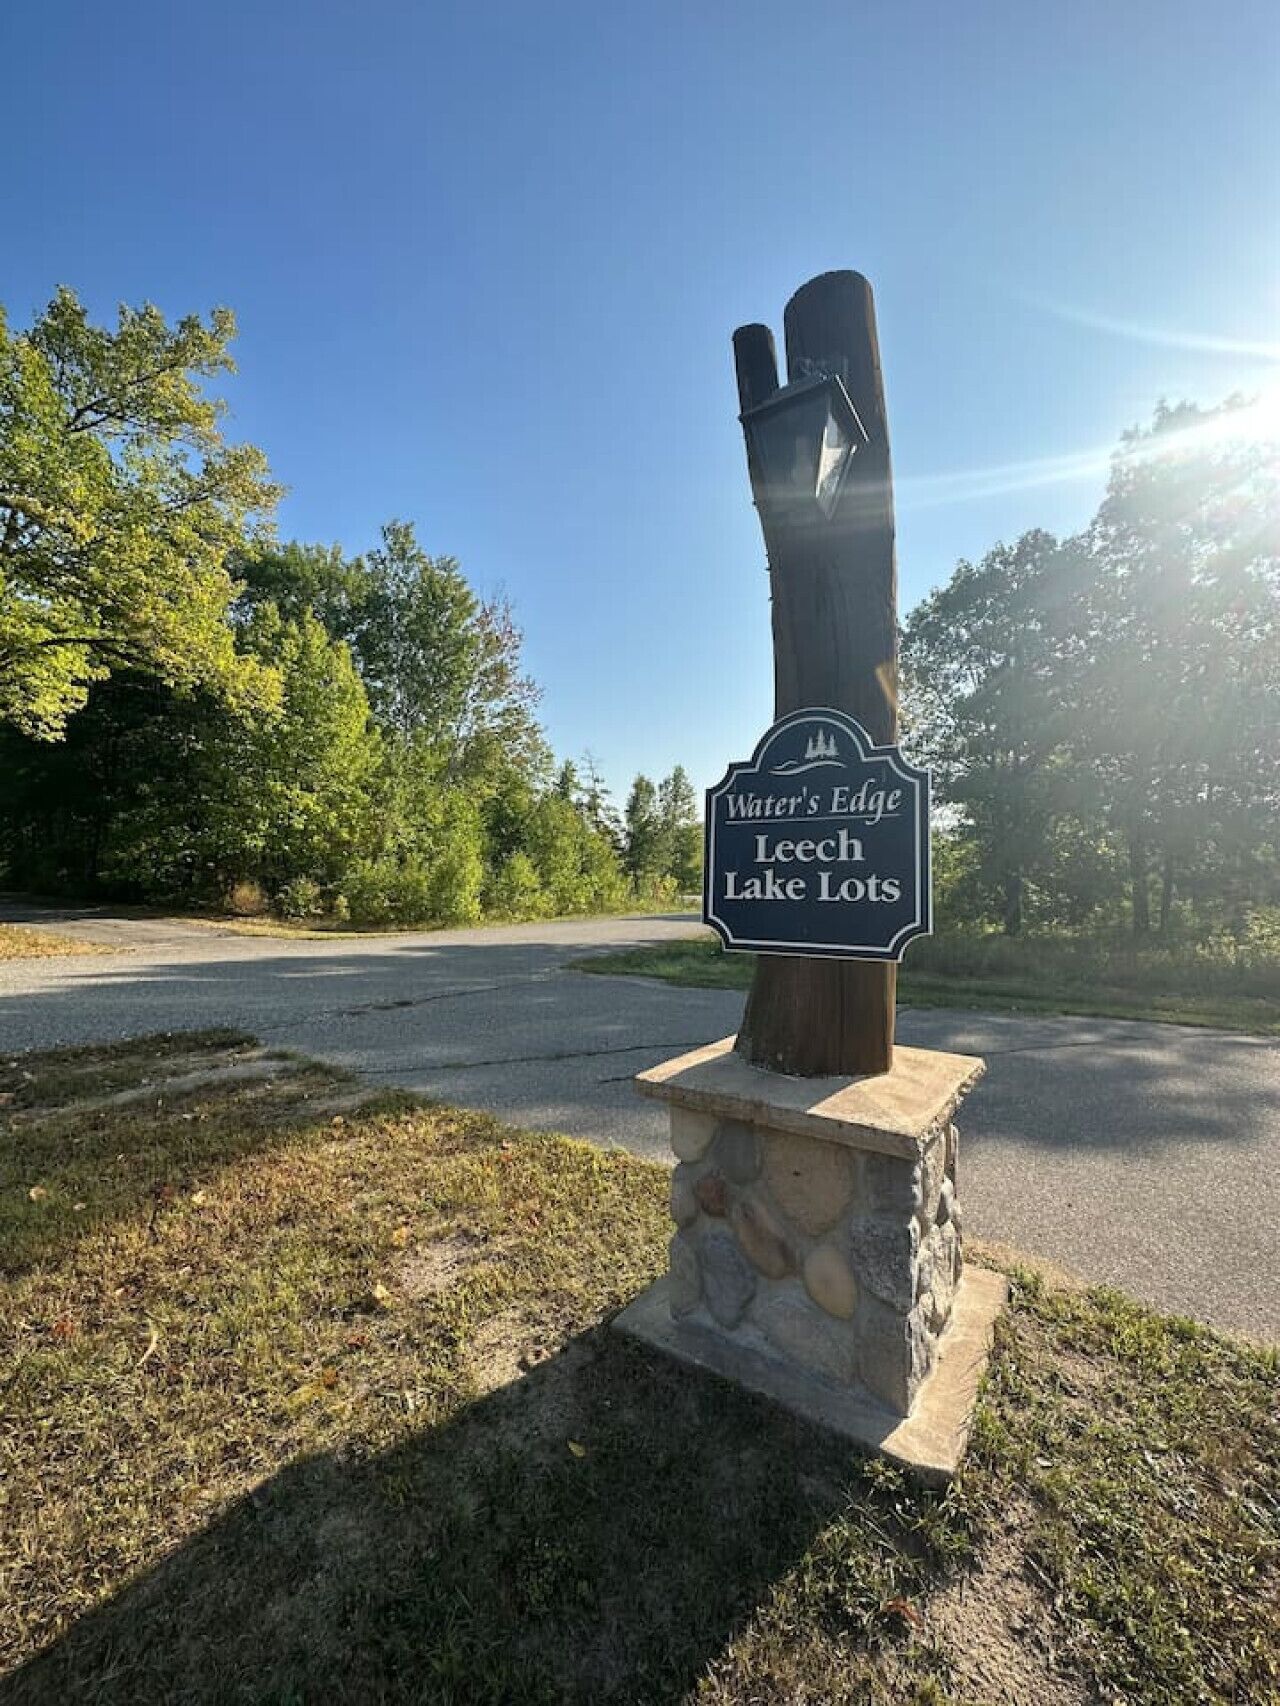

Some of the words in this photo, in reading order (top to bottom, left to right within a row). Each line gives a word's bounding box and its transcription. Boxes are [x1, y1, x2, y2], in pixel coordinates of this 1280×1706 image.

[725, 786, 820, 819] Water's
[830, 778, 902, 825] Edge
[753, 828, 866, 863] Leech
[724, 869, 807, 900] Lake
[817, 872, 902, 902] Lots
